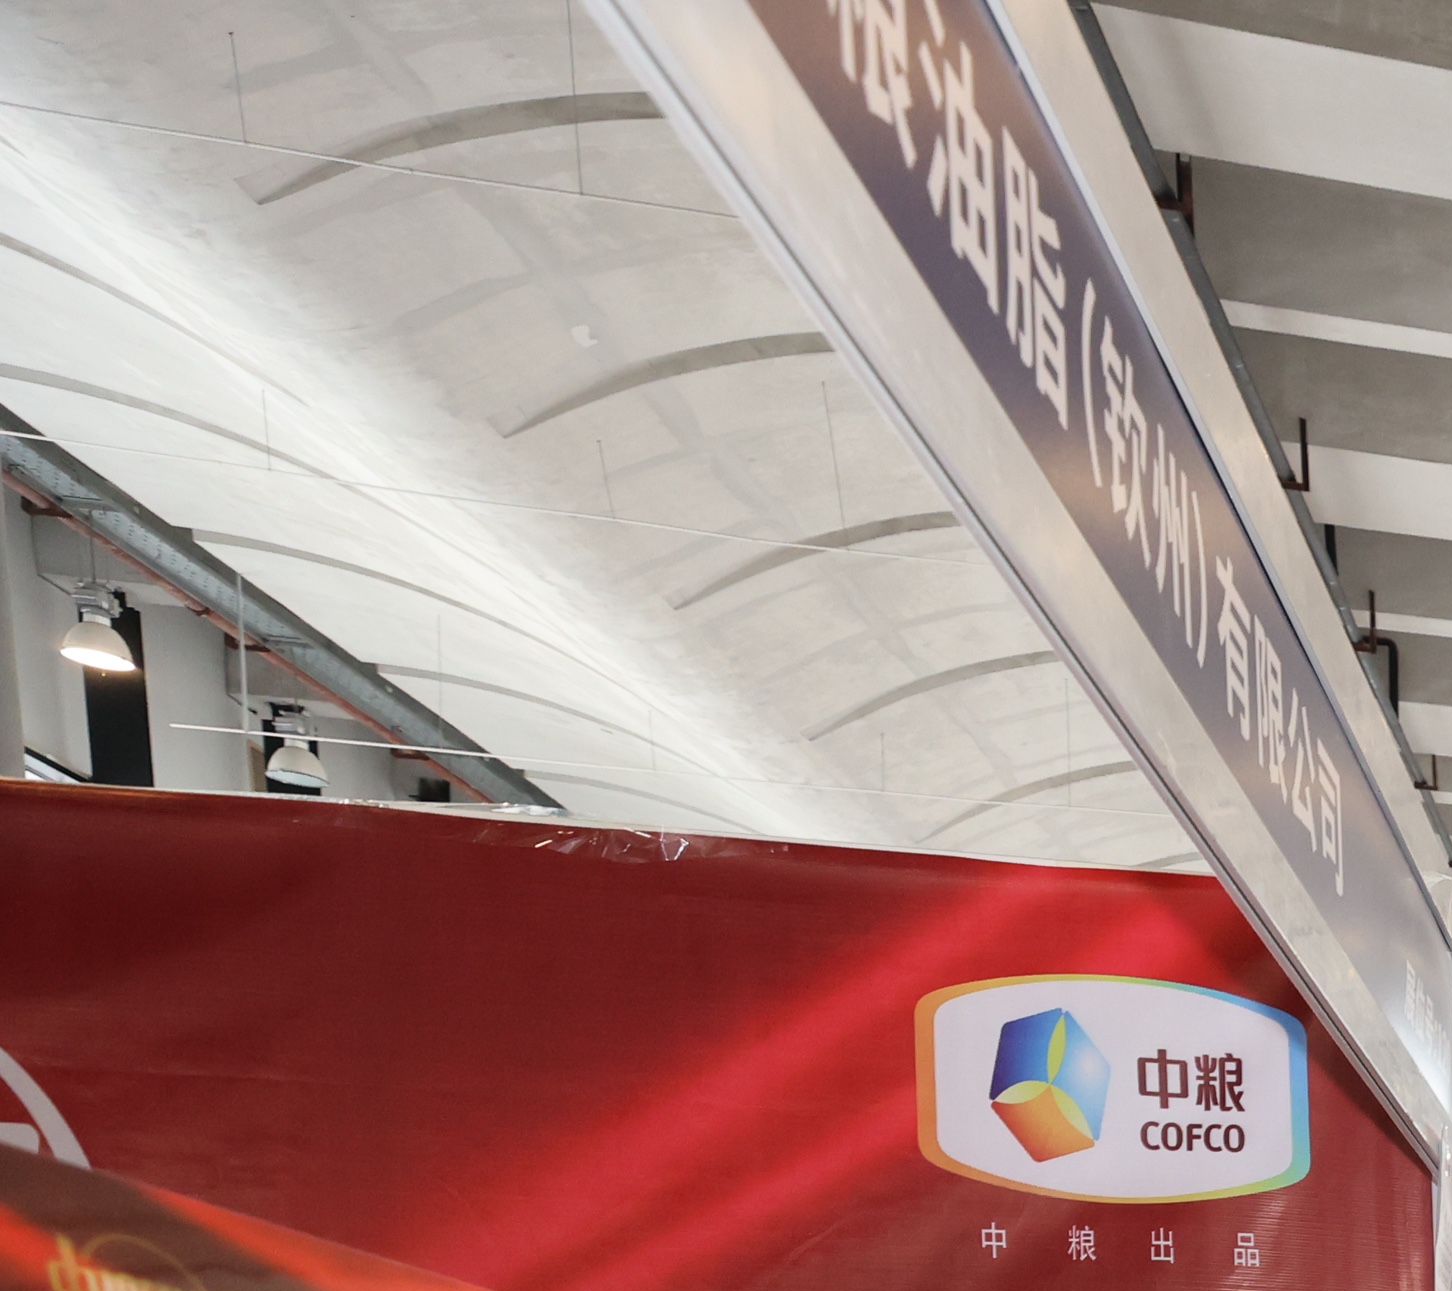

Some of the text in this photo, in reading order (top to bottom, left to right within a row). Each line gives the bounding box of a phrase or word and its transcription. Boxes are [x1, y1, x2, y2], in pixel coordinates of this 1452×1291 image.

[1137, 1049, 1245, 1111] 中粮
[1140, 1121, 1245, 1152] COFCO
[981, 1222, 1260, 1267] 中粮出品
